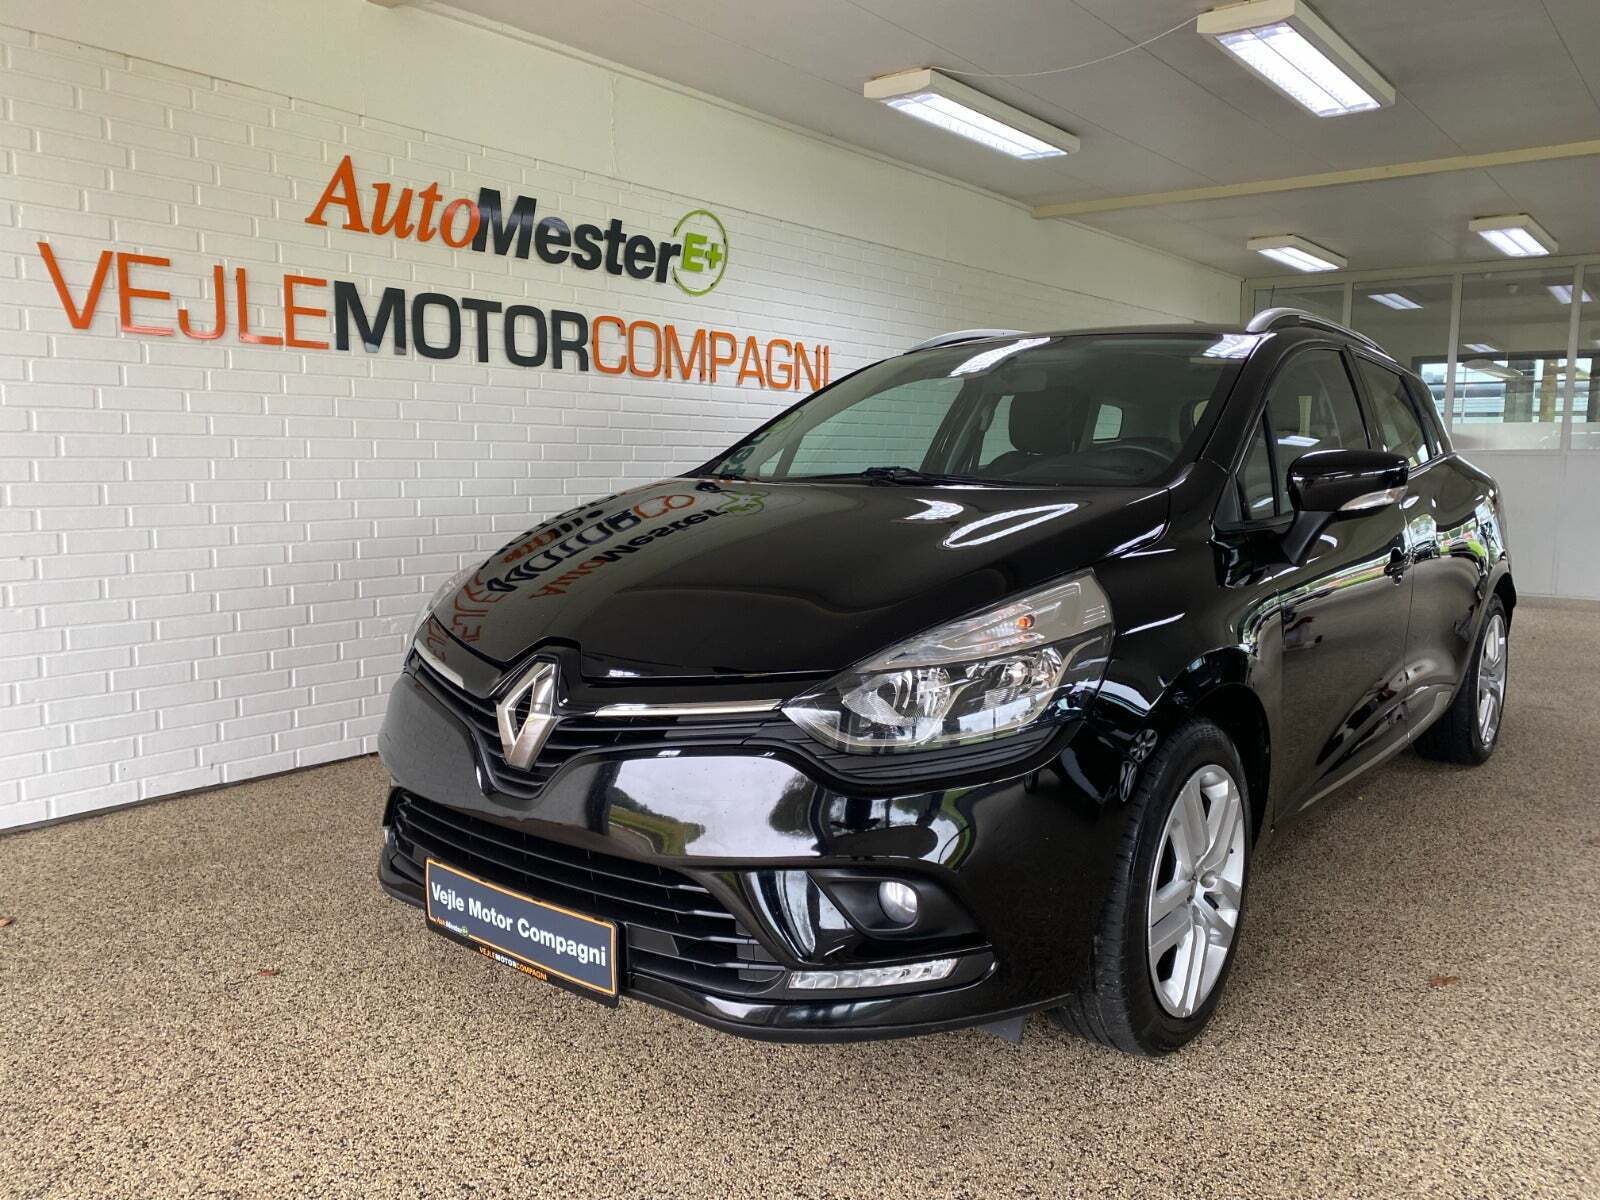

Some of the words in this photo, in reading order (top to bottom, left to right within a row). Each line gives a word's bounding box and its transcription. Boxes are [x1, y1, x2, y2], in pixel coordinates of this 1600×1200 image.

[304, 155, 682, 284] AutoMester
[431, 881, 465, 911] Vejle
[468, 897, 514, 931] Motor
[517, 917, 607, 967] Compagni
